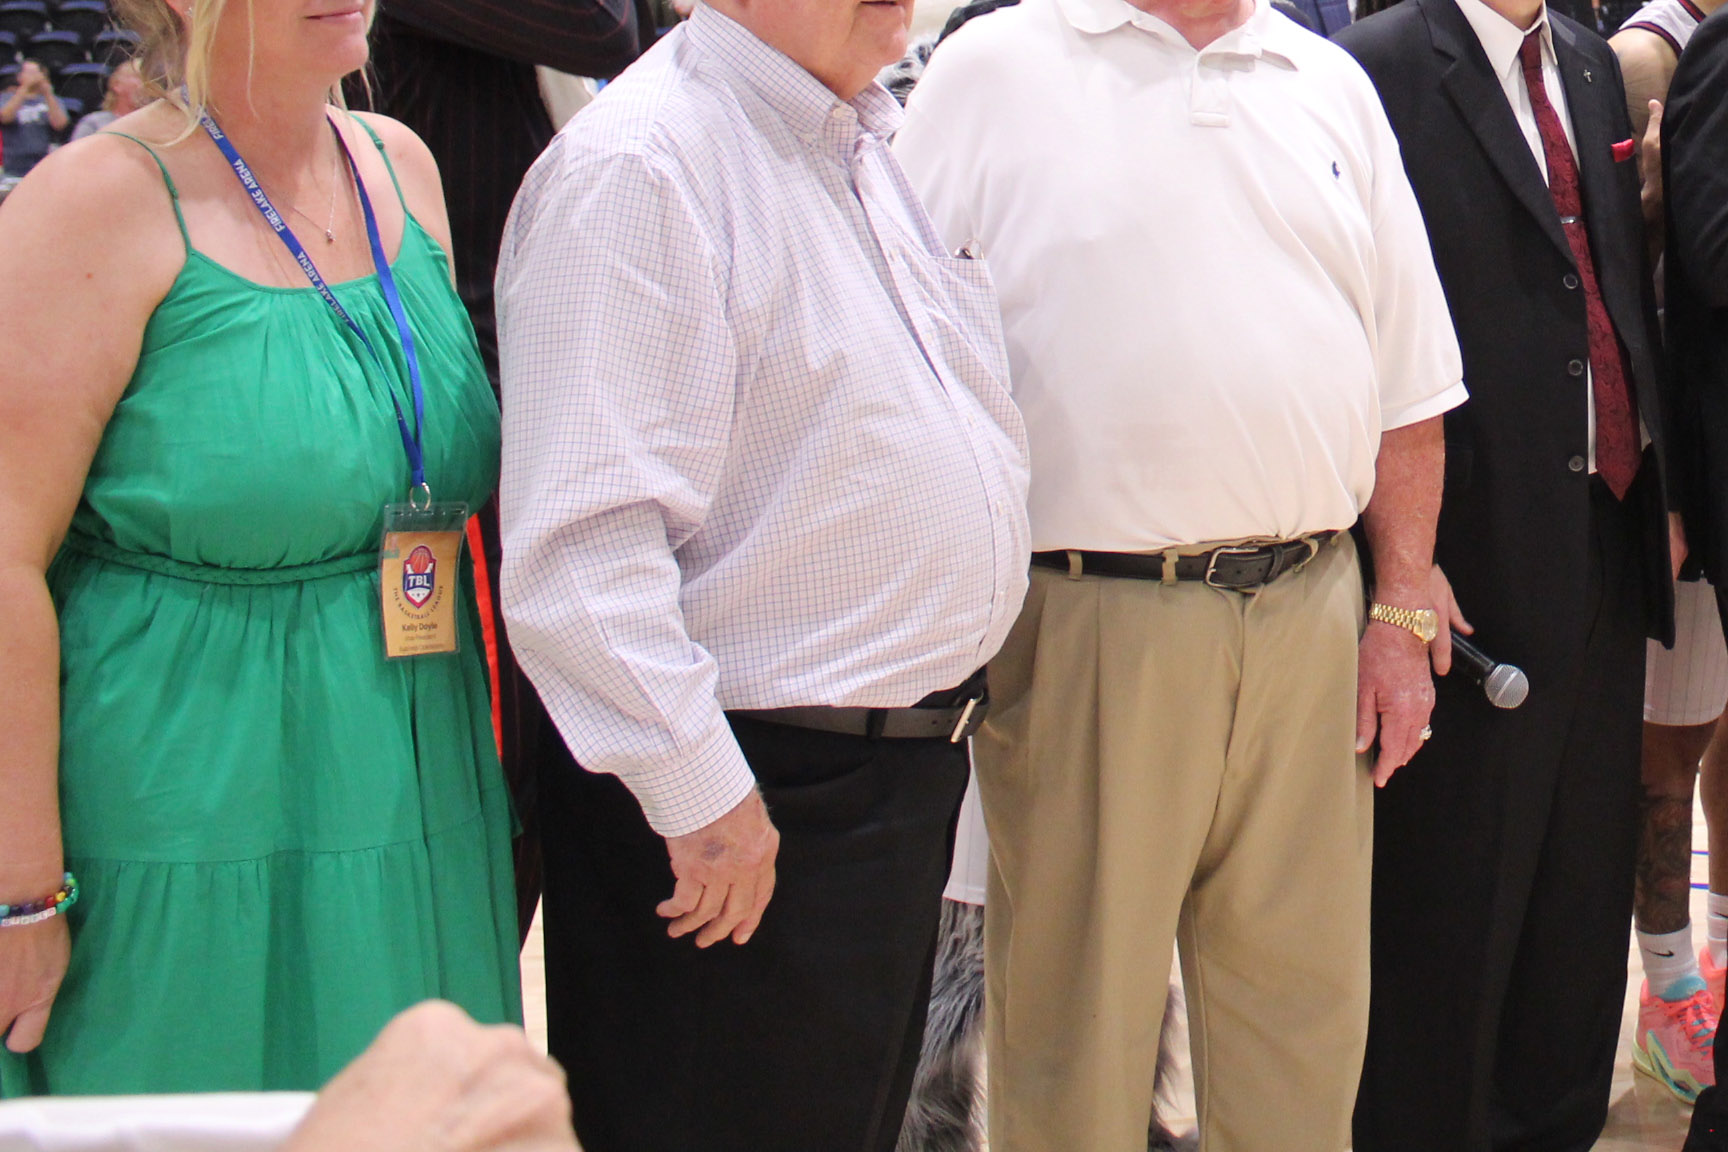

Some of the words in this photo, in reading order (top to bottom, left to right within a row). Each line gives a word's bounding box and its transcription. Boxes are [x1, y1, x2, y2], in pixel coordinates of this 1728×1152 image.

[233, 158, 259, 190] ARENA
[251, 187, 286, 233] FIRELAKE
[297, 250, 322, 286] ARENA
[408, 574, 431, 588] TBL
[402, 623, 418, 633] Kelly
[419, 622, 438, 632] Doyle
